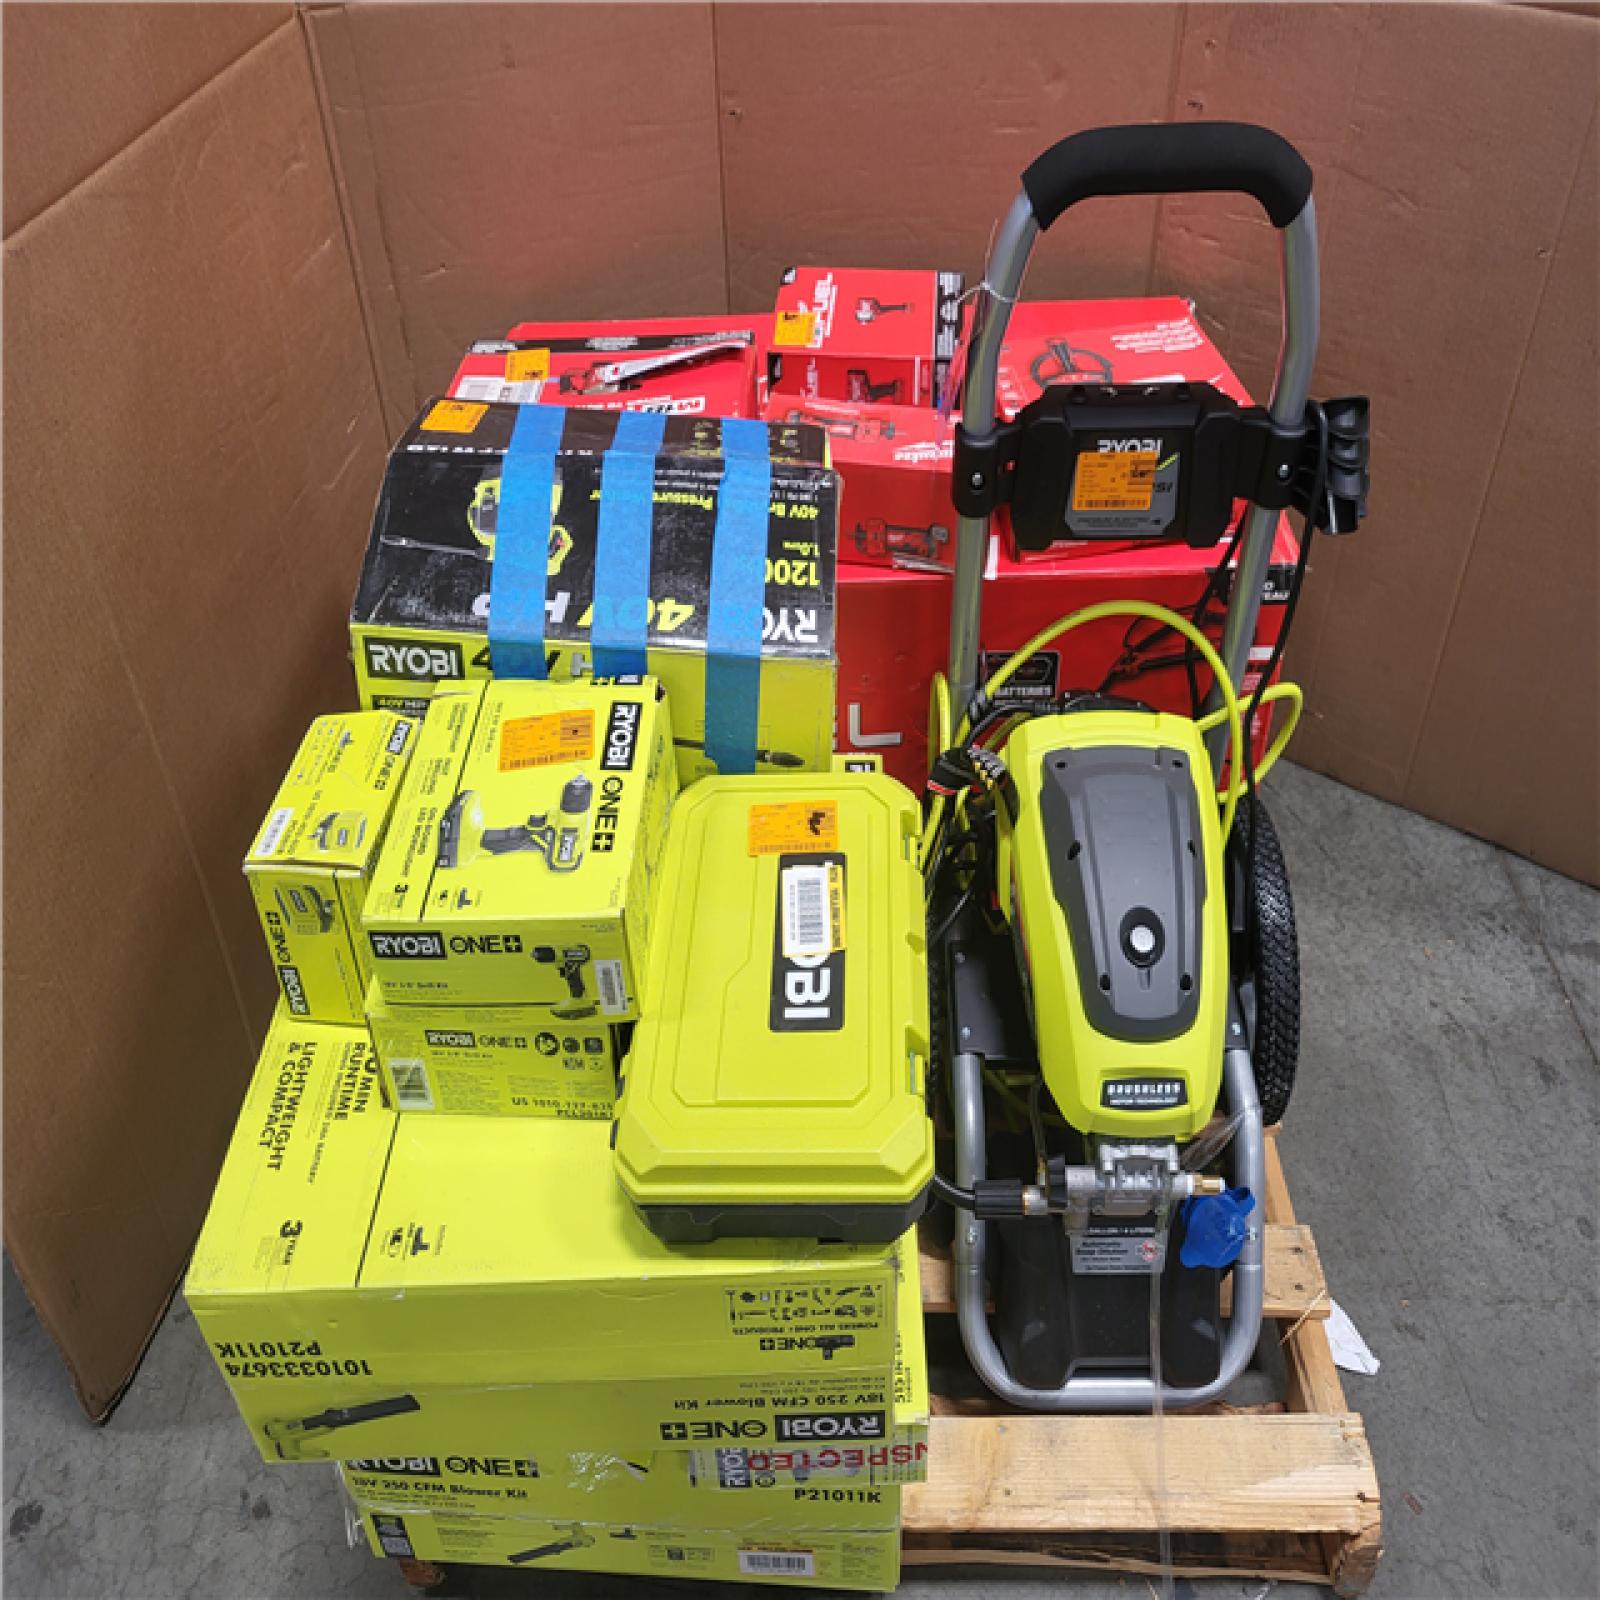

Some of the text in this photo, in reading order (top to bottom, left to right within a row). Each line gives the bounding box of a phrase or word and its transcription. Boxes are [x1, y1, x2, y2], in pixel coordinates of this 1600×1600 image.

[368, 644, 458, 676] RYOBI
[606, 703, 635, 767] RYOBI
[372, 935, 443, 957] RYOBI
[334, 1041, 367, 1121] RUNTIME
[259, 1041, 301, 1148] & COMPACT
[267, 1041, 318, 1171] LIGHTWEIGHT
[280, 1219, 303, 1238] 3
[214, 1340, 323, 1359] P21011K
[225, 1359, 374, 1378] 1010333674
[705, 1397, 766, 1408] Blower
[771, 1396, 809, 1407] CFM
[782, 1415, 882, 1437] RYOBI
[795, 1487, 881, 1503] P21011K
